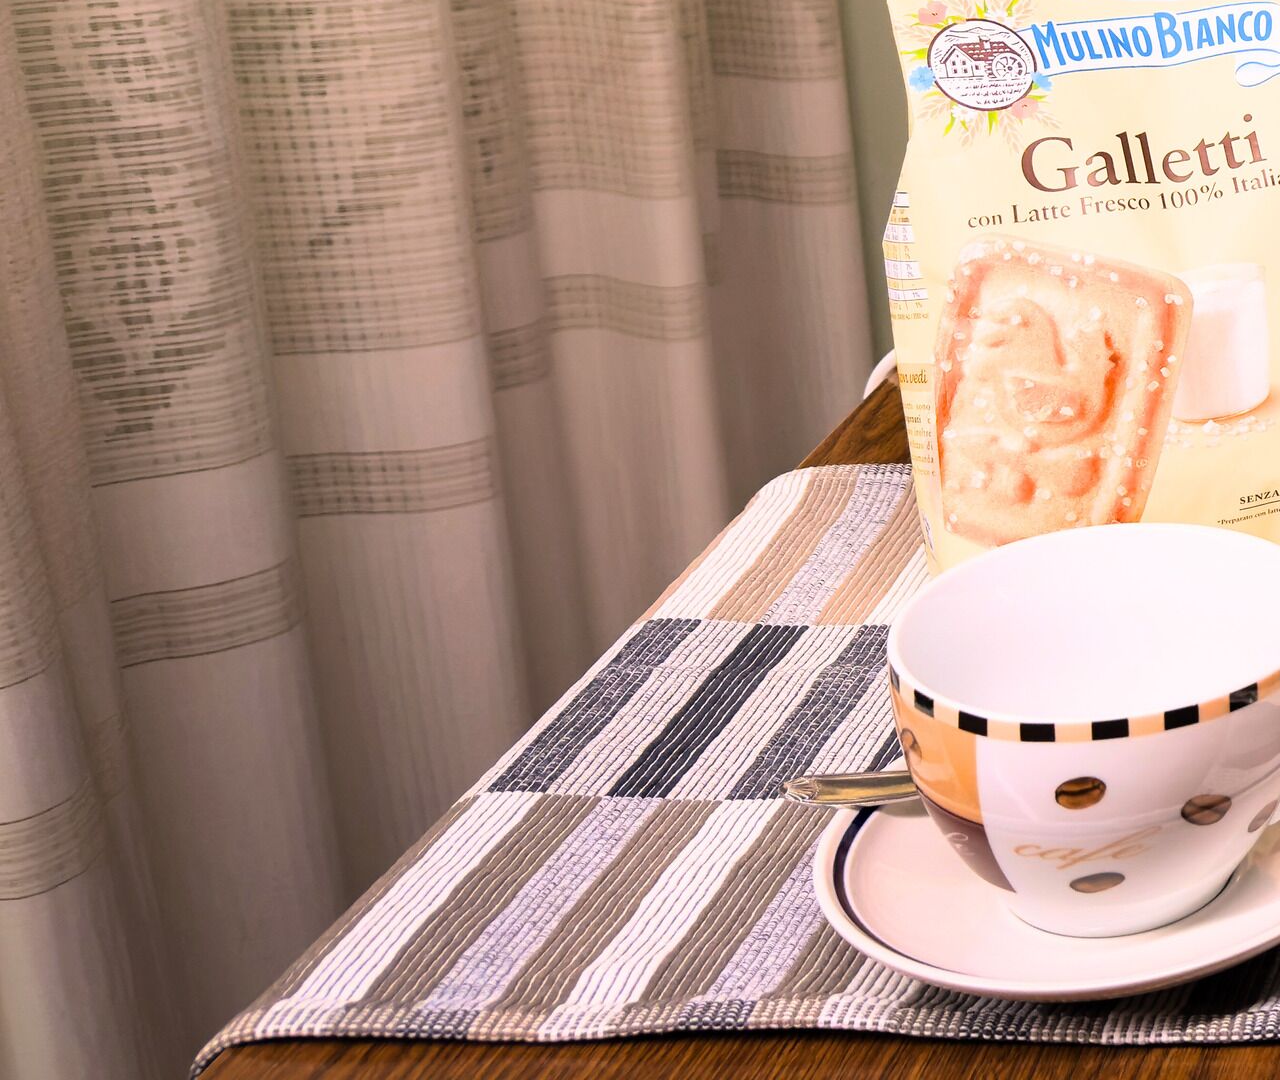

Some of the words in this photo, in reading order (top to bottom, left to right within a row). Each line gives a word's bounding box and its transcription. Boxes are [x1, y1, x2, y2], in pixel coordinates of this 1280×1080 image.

[1030, 21, 1152, 69] MULINO
[1153, 10, 1273, 60] BIANCO
[1020, 113, 1269, 194] Galletti
[967, 212, 1003, 229] con
[1011, 202, 1071, 225] Latte
[1080, 194, 1151, 217] Fresco
[1158, 184, 1224, 211] 100%
[1239, 489, 1280, 505] SENZA
[1013, 825, 1162, 870] cafe
